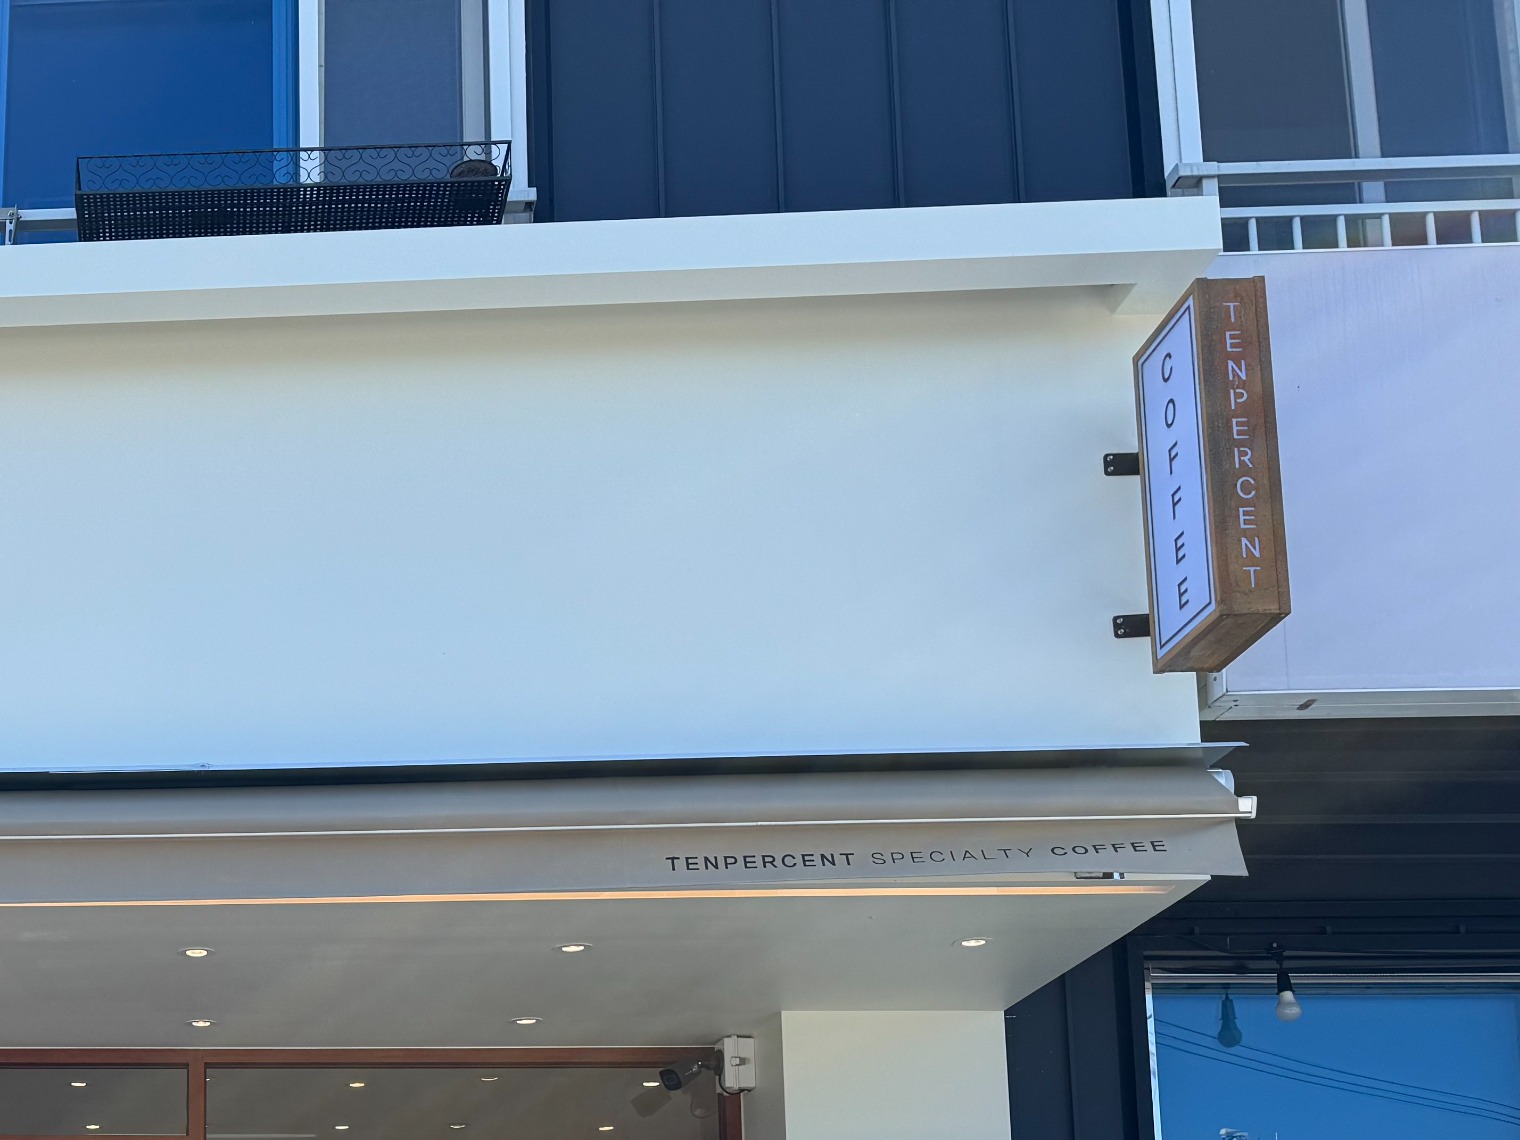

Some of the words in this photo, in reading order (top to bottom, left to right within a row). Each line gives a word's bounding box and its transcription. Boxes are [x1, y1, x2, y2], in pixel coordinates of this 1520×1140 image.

[1161, 352, 1189, 610] COFFEE
[1222, 302, 1261, 588] TENPERCENT
[665, 853, 855, 872] TENPERCENT
[871, 848, 1033, 865] SPECIALTY
[1050, 840, 1168, 857] COFFEE
